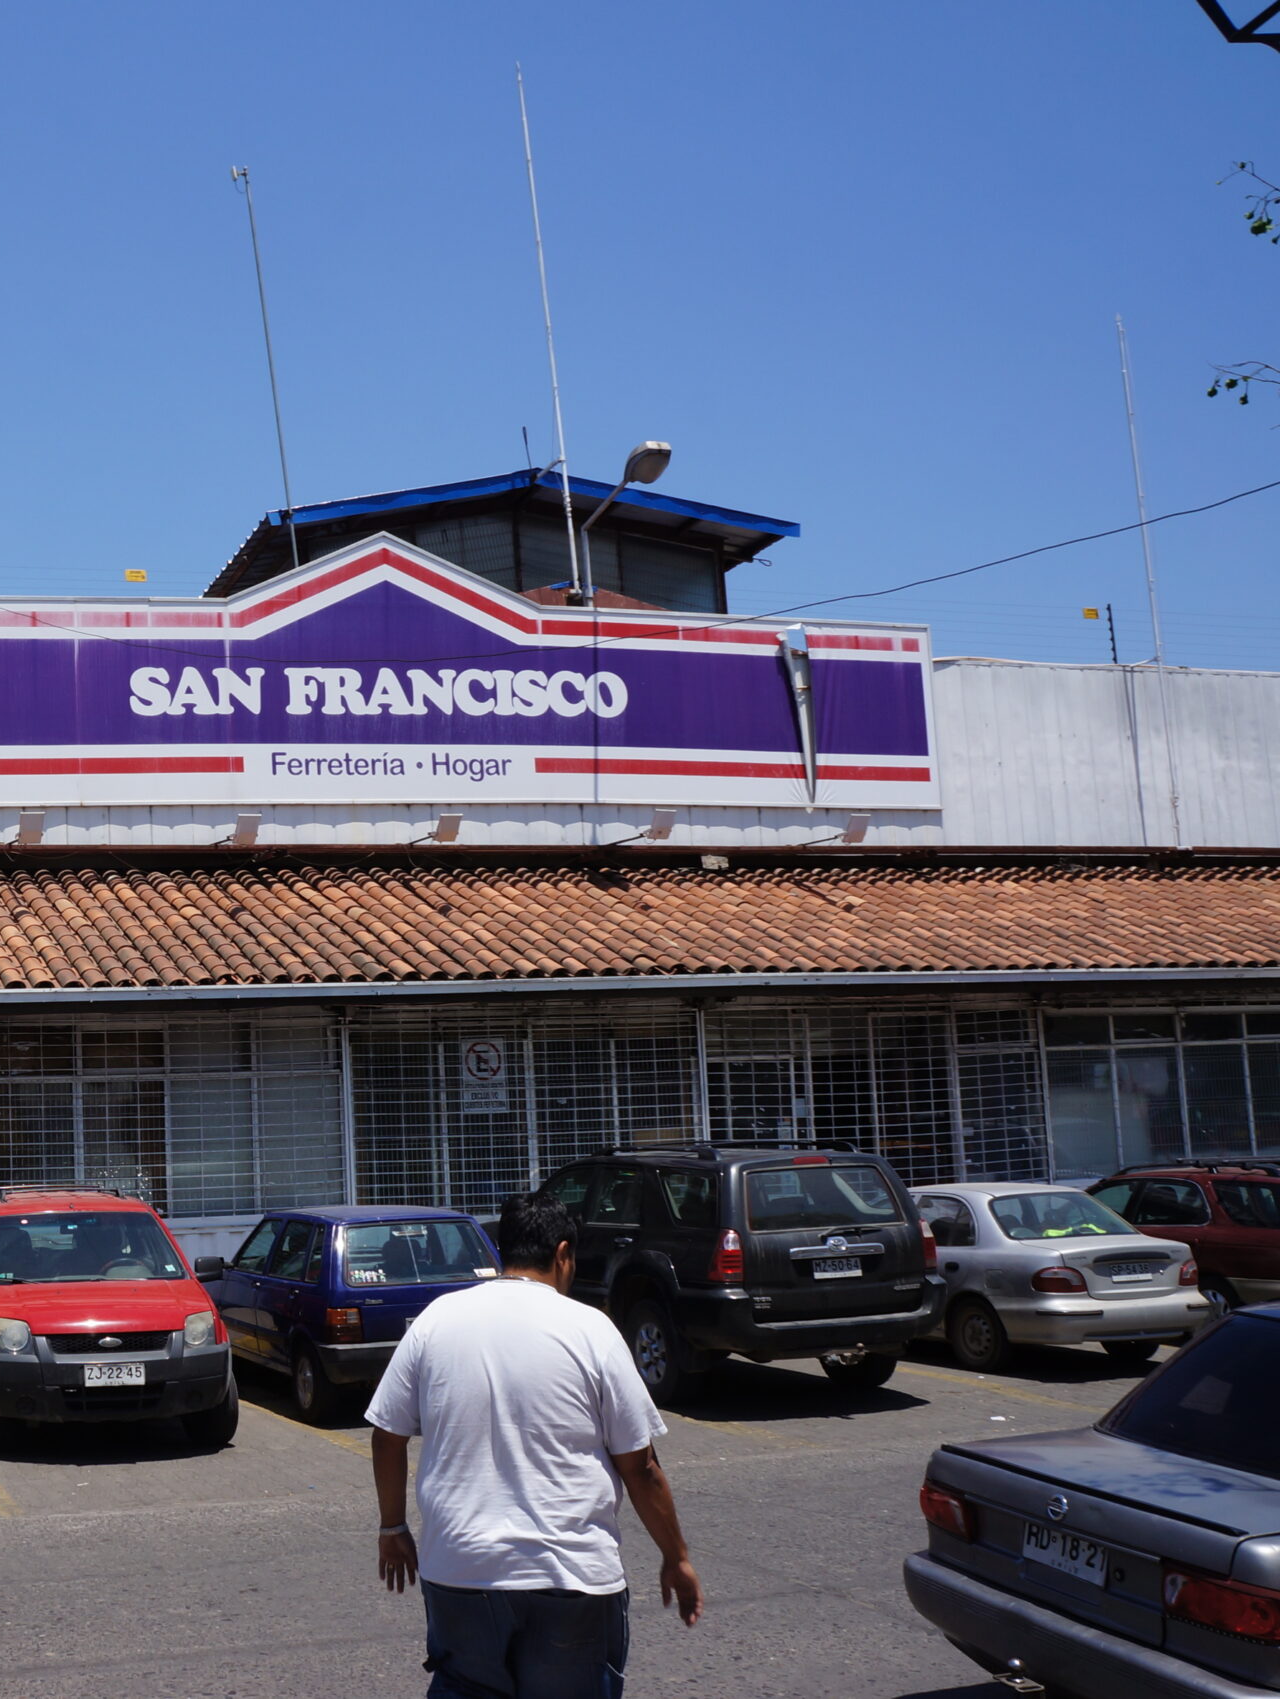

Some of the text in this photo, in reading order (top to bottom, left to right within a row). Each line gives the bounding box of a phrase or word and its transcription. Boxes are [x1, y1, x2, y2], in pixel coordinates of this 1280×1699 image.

[129, 666, 628, 718] SAN FRANCISCO
[271, 751, 512, 782] Ferretería Hogar
